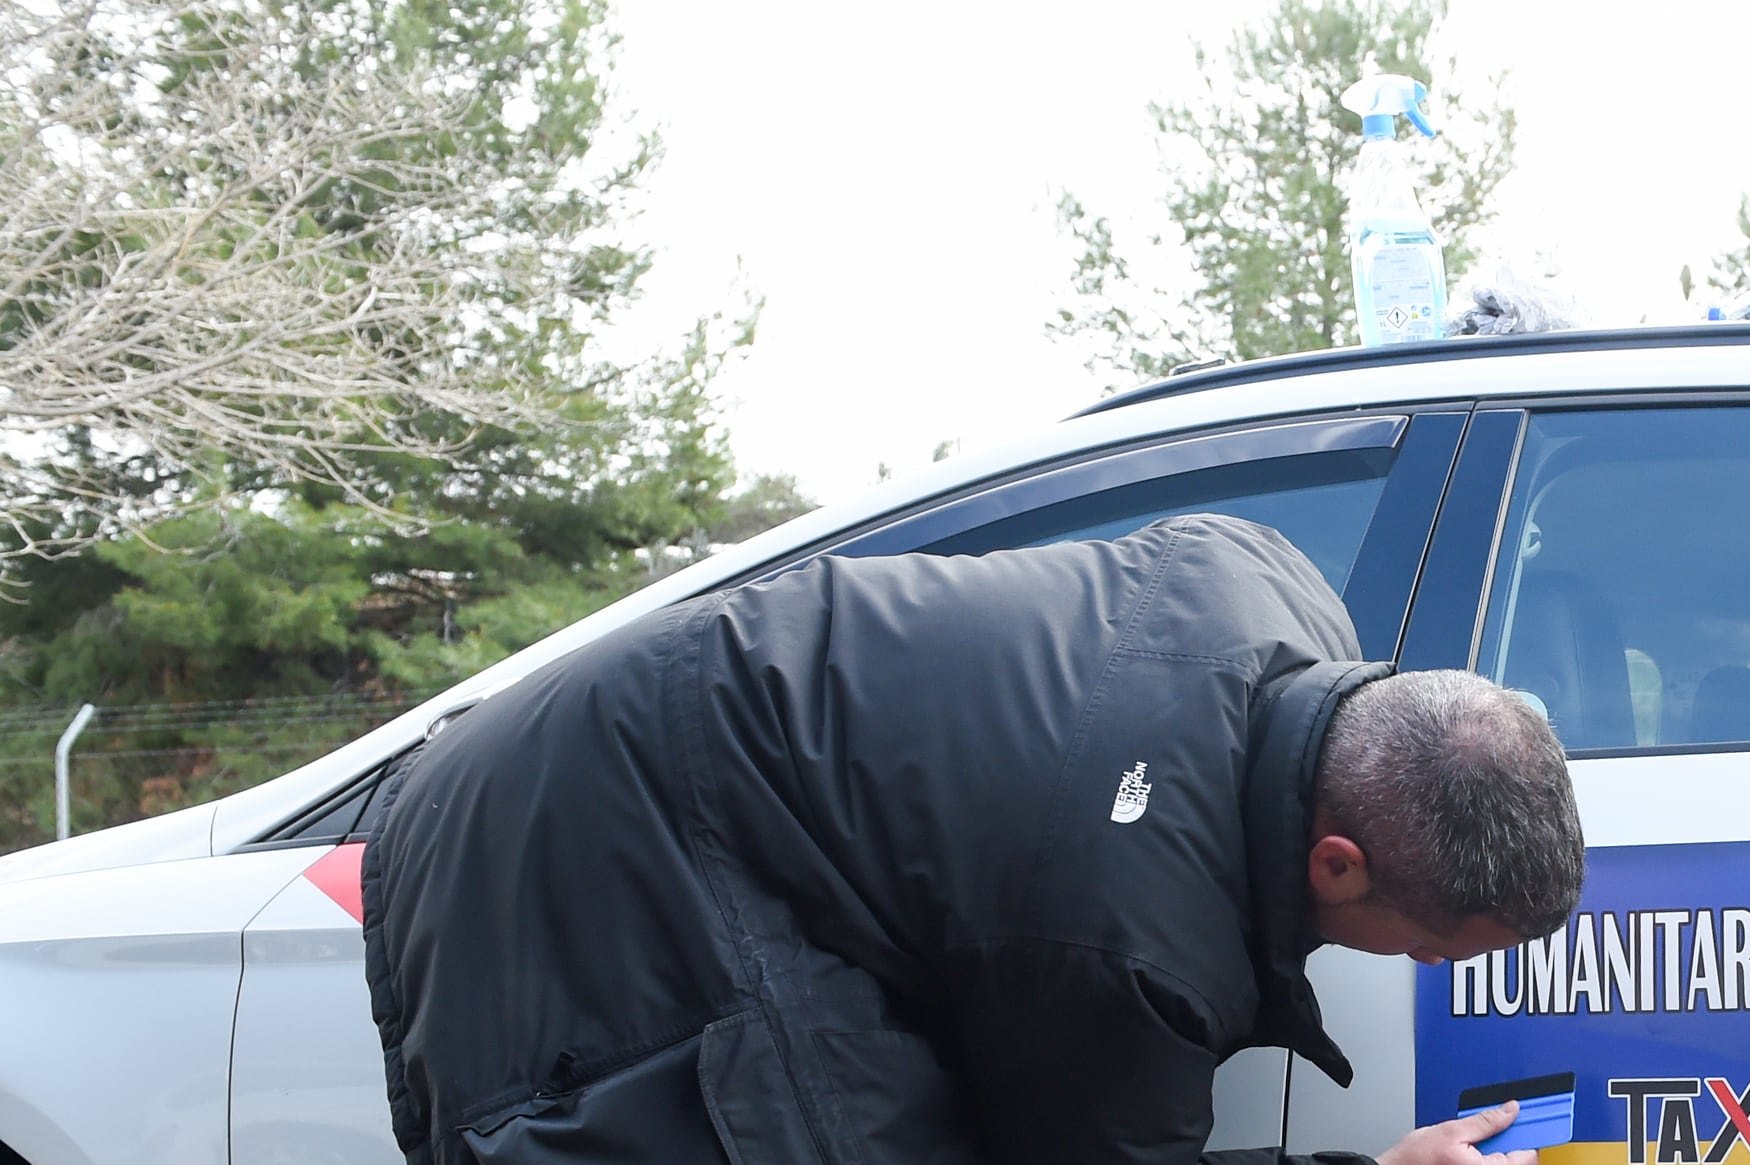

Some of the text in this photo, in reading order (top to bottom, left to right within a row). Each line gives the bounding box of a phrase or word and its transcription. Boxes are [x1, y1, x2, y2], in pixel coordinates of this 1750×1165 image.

[1117, 771, 1133, 802] FACE
[1126, 761, 1148, 804] NORTH
[1138, 783, 1152, 806] THE
